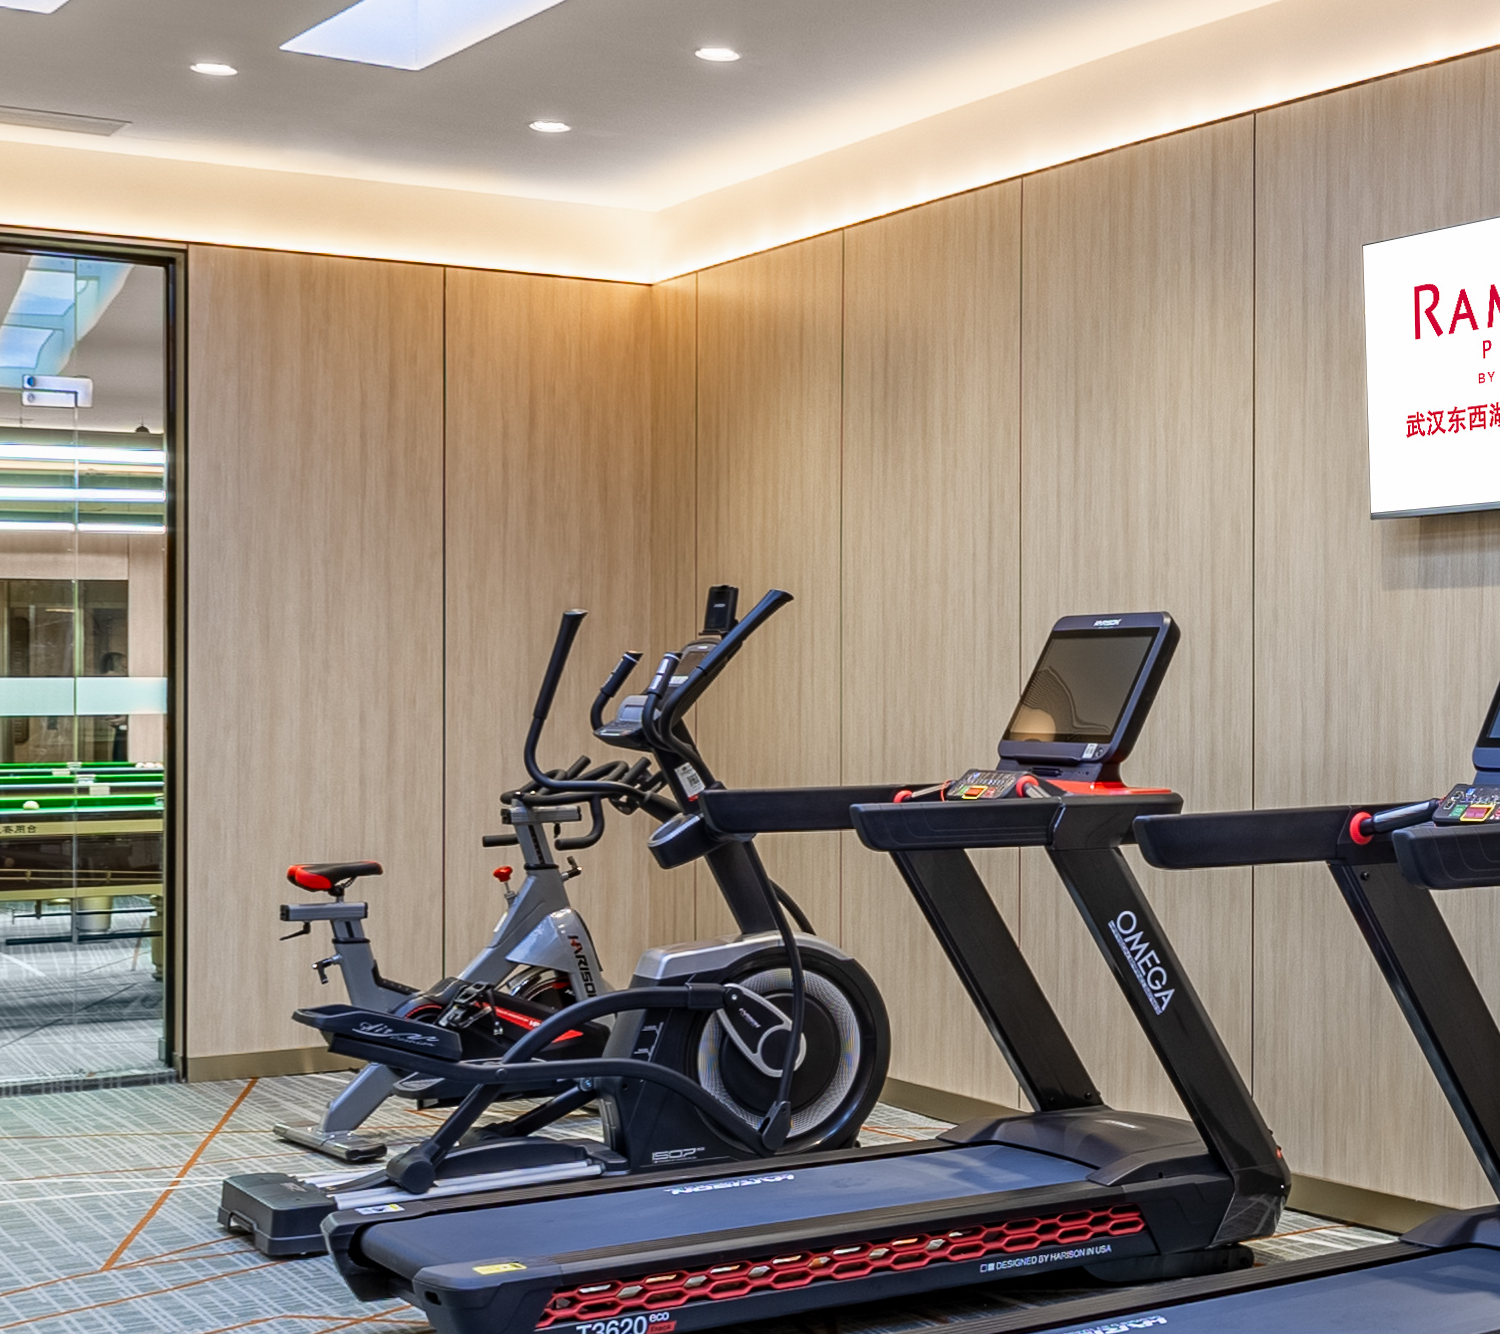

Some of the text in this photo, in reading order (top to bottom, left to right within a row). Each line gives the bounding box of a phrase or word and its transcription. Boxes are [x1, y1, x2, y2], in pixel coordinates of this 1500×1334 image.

[1477, 371, 1496, 384] BY
[567, 935, 598, 997] HARISO
[1116, 910, 1176, 1012] OMEGA
[995, 1244, 1112, 1271] DESIGNED BY HARISON IN USA
[648, 1311, 670, 1323] eco
